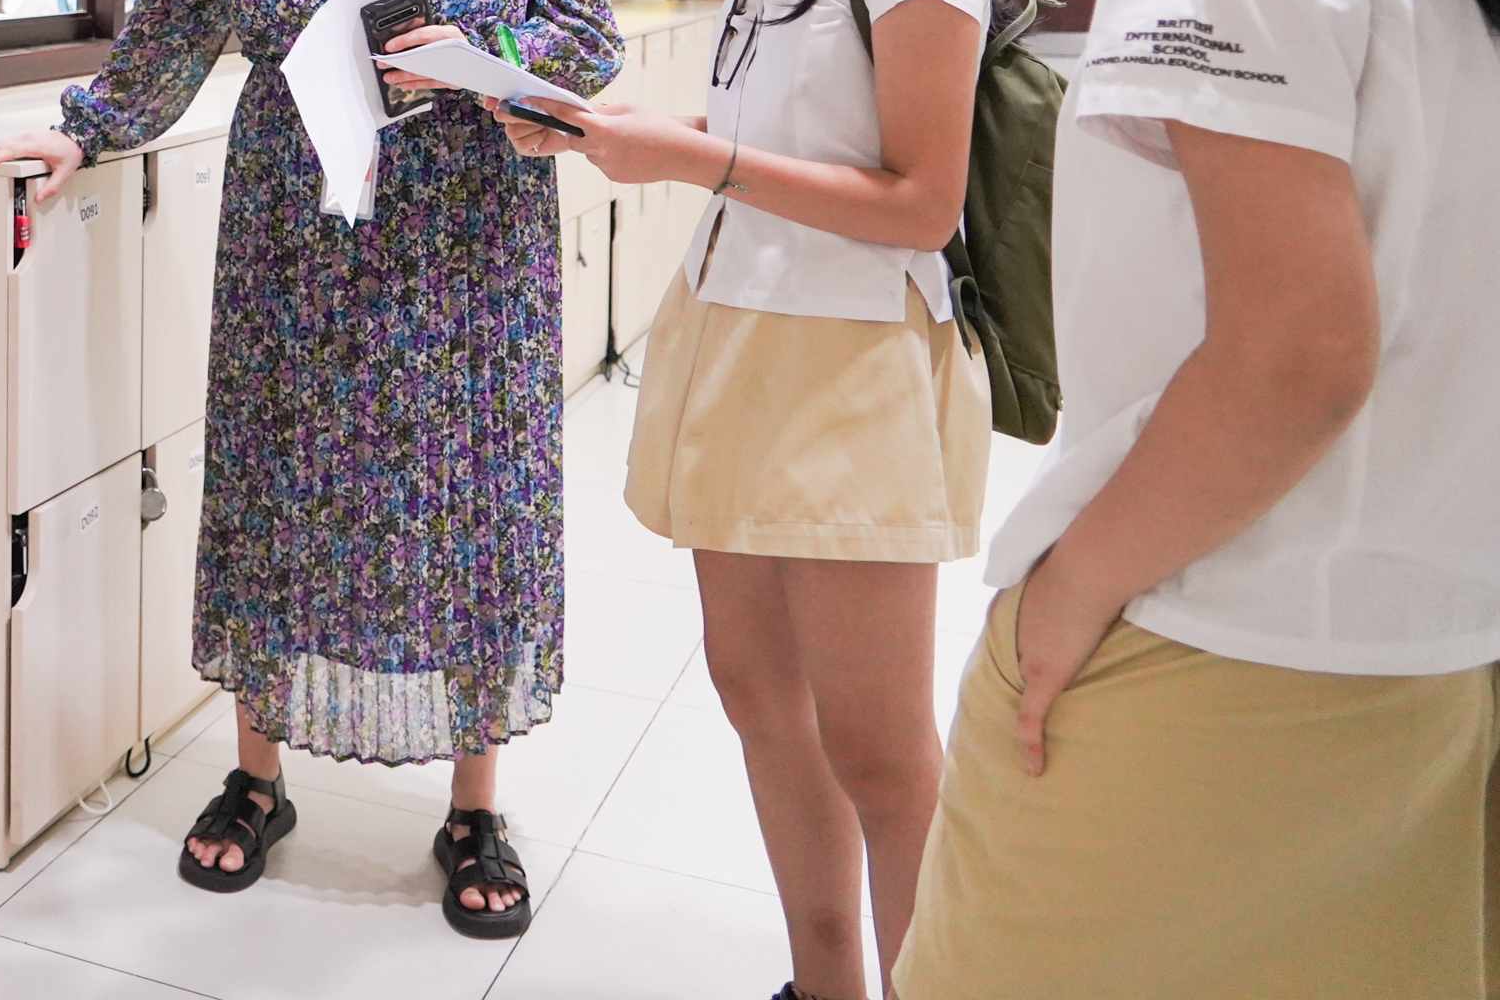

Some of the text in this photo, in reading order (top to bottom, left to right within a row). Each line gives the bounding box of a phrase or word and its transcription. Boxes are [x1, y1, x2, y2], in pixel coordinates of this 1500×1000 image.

[1156, 19, 1213, 35] BRITISH
[1124, 32, 1245, 54] INTERNATIONAL
[1152, 44, 1210, 63] SCHOOL
[1233, 70, 1289, 86] SCHOOL
